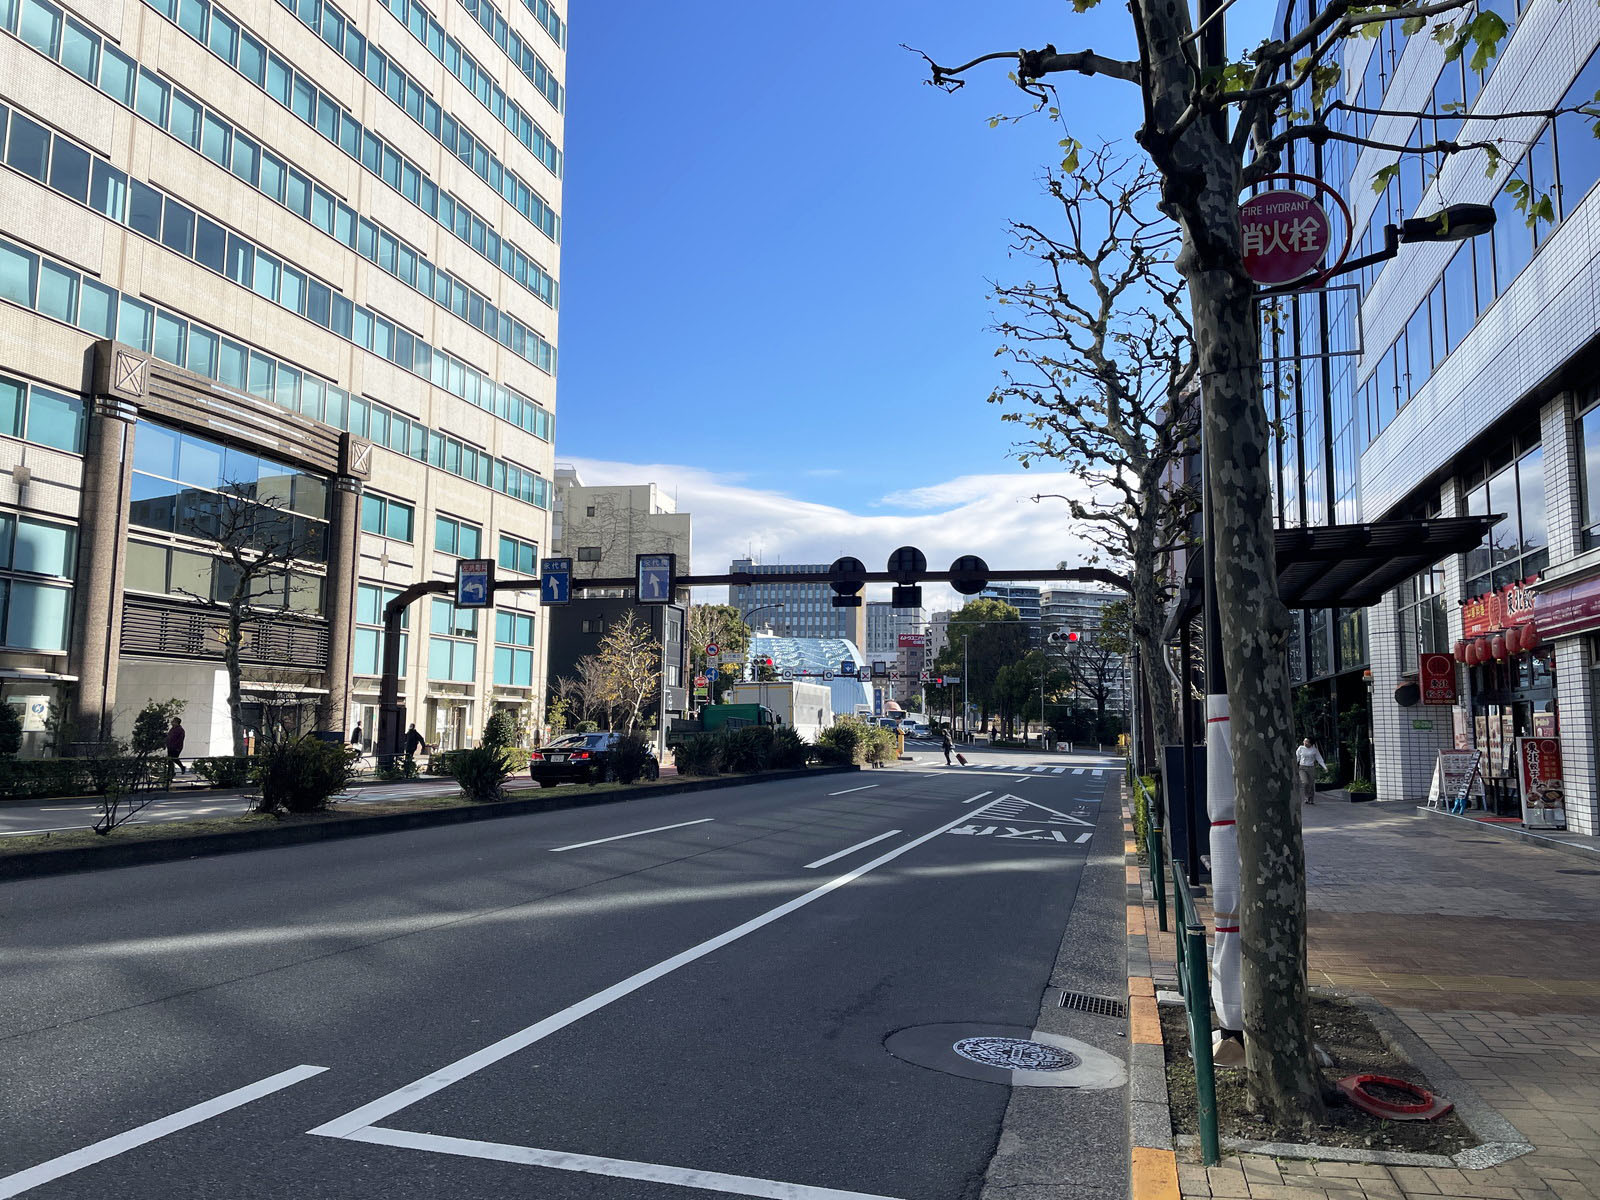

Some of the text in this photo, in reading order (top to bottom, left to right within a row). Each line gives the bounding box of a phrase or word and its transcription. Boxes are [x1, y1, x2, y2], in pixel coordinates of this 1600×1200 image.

[1242, 201, 1310, 216] FIRE HYDRANT
[1431, 679, 1449, 689] 東北
